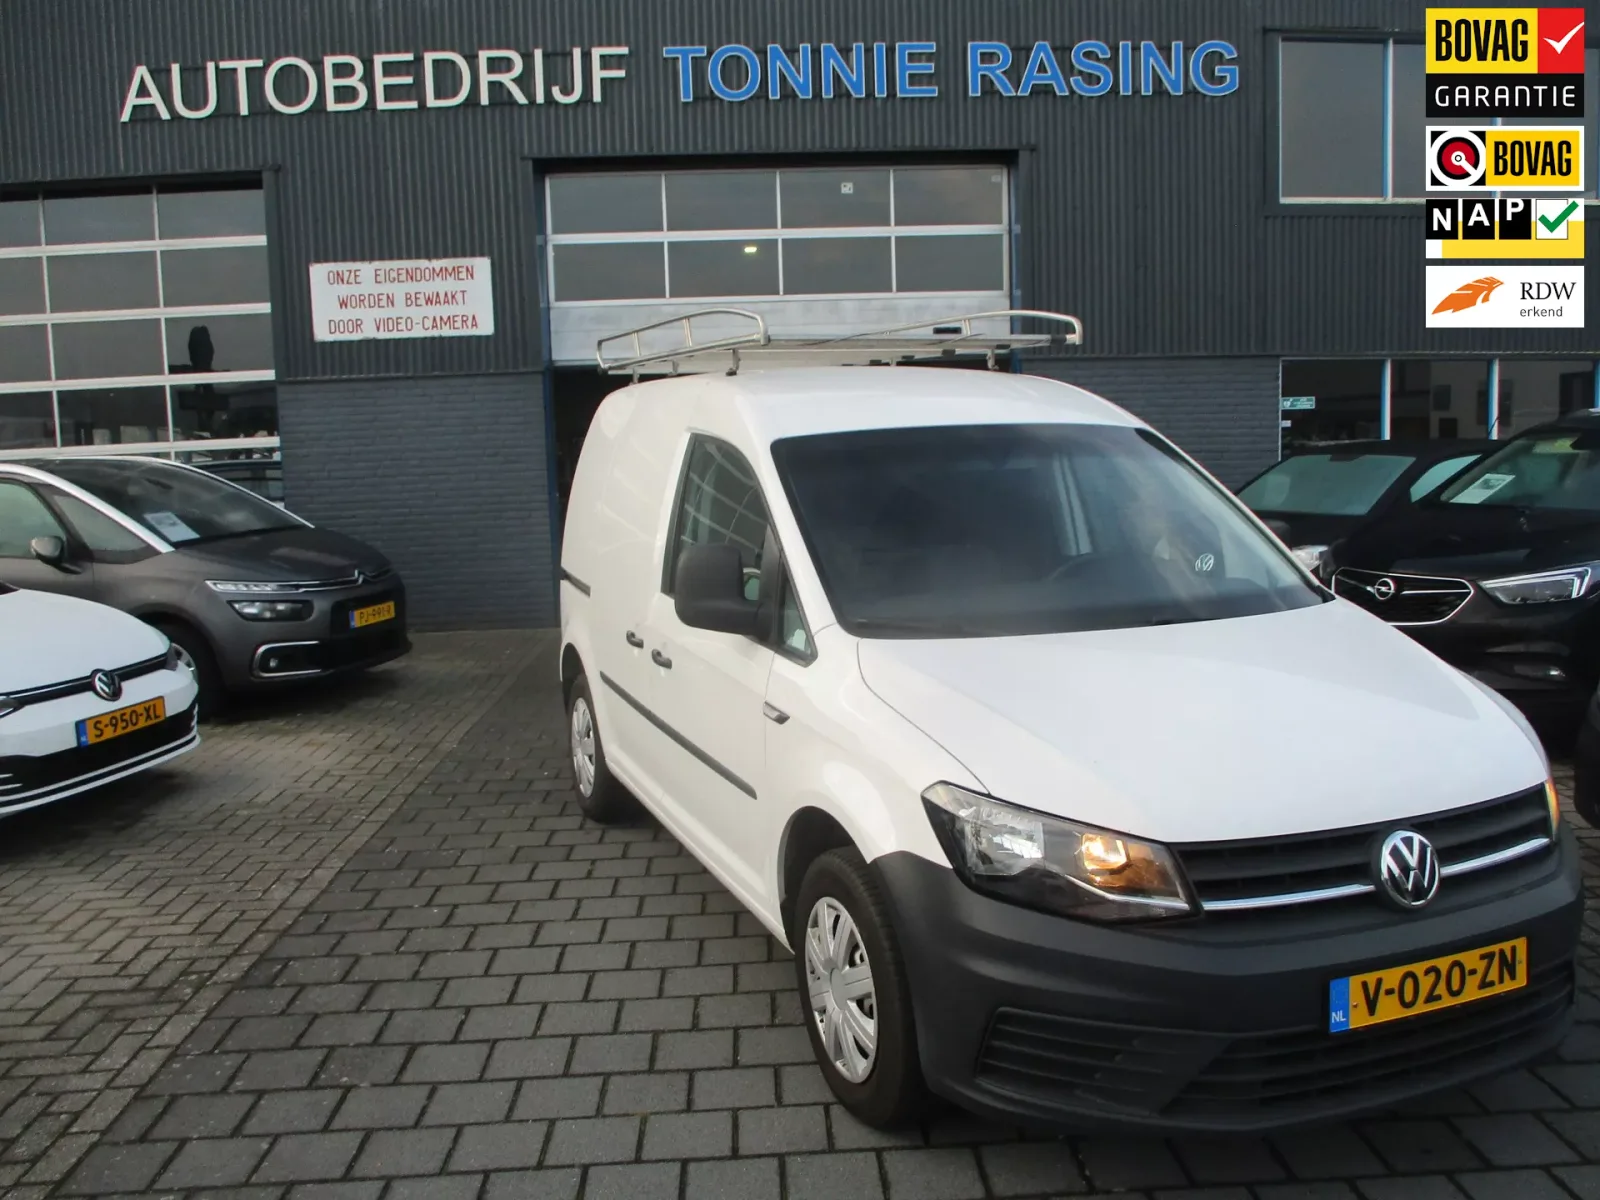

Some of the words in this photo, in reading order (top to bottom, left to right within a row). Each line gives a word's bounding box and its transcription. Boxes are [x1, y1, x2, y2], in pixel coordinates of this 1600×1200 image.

[120, 46, 630, 122] AUTOBEDRIJF
[663, 41, 938, 101] TONNIE
[967, 40, 1240, 97] RASING
[327, 269, 362, 285] ONZE
[374, 265, 475, 284] EIGENDOMMEN
[338, 293, 395, 310] WORDEN
[405, 290, 468, 307] BEWAAKT
[328, 318, 364, 335] DOOR
[374, 314, 479, 333] VIDEO-CAMERA
[93, 703, 160, 738] S-950-XL
[1361, 945, 1518, 1017] V-020-ZN
[1331, 1010, 1347, 1023] NL
